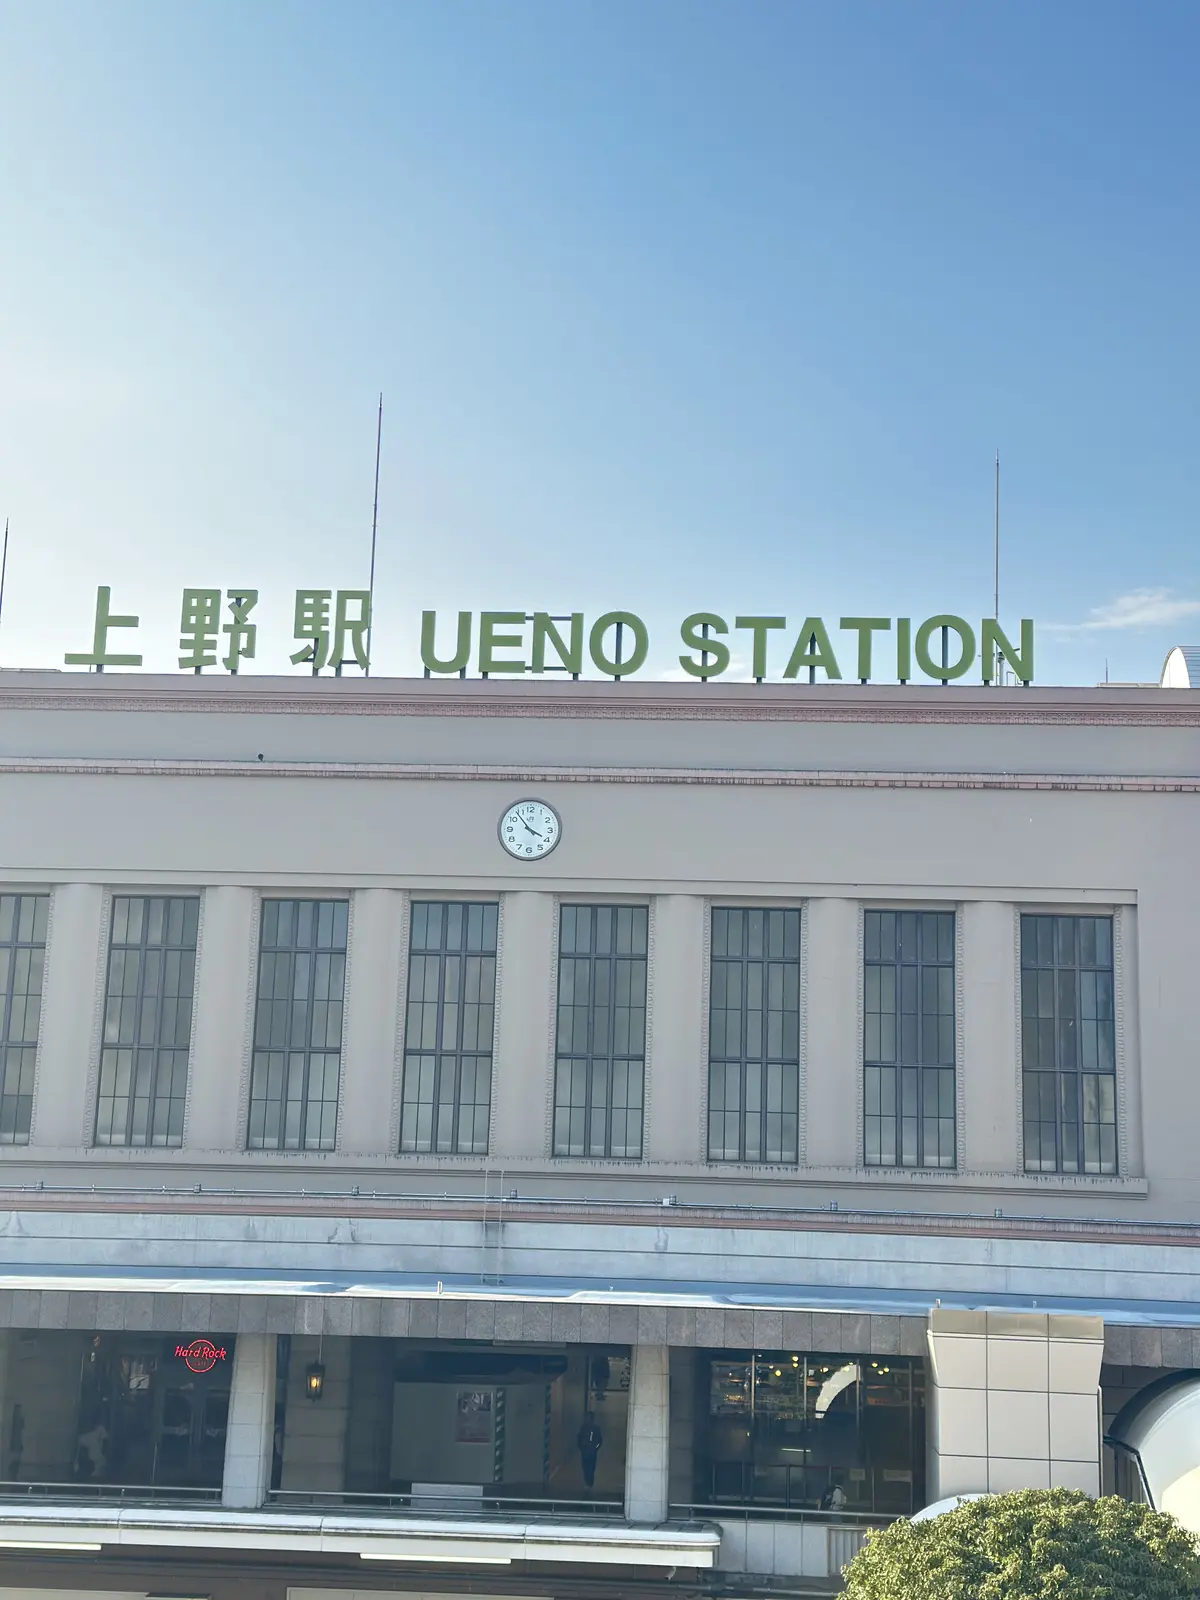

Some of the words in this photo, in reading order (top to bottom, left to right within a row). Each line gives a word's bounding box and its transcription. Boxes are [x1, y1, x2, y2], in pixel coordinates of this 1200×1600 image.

[65, 586, 371, 670] 上野駅
[421, 611, 649, 676] UENO
[679, 612, 1034, 681] STATION
[174, 1346, 201, 1358] Hard
[202, 1346, 226, 1360] Rock
